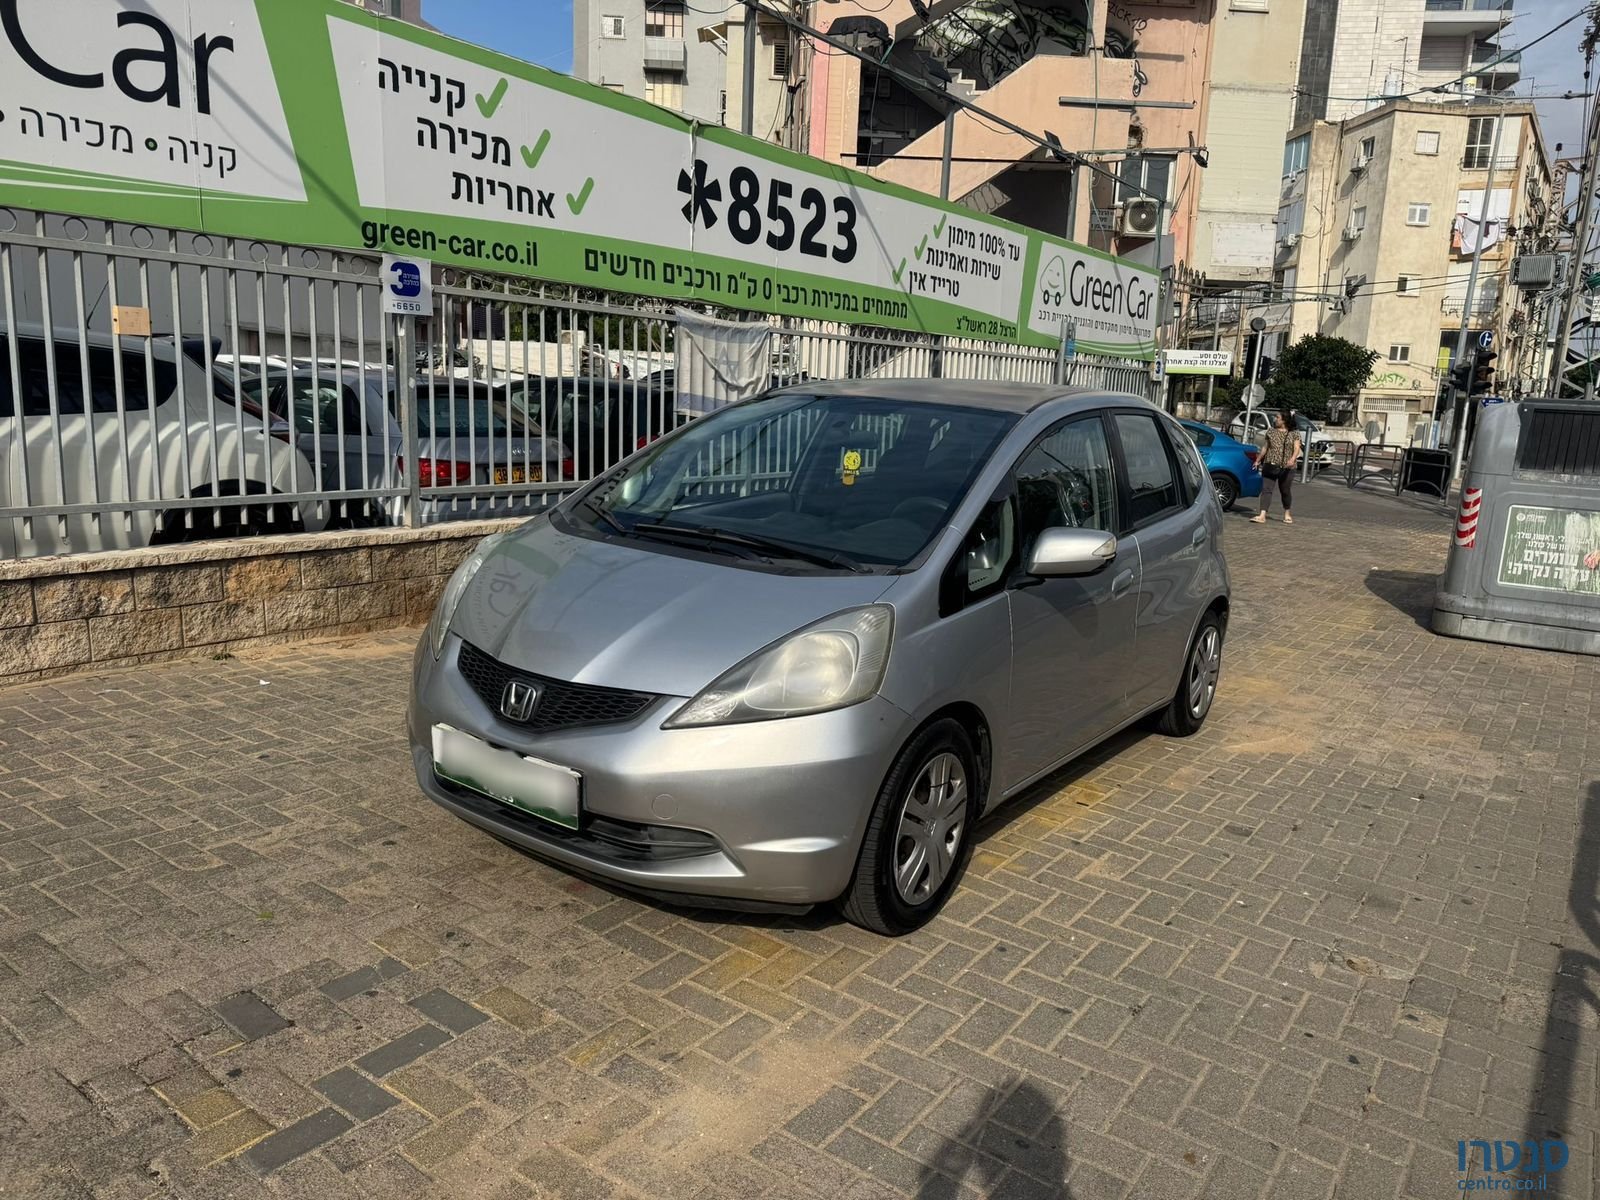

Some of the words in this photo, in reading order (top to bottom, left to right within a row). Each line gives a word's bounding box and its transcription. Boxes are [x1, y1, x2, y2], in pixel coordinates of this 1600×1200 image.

[0, 0, 234, 115] Car
[378, 58, 466, 117] קנייה
[20, 107, 133, 153] מכירה
[417, 117, 511, 167] מכירה
[168, 136, 236, 178] קניה
[451, 171, 555, 219] אחריות
[361, 220, 538, 267] green-car.co.il
[948, 225, 976, 249] מימון
[980, 232, 1005, 257] 100%
[926, 247, 969, 273] ואמינות
[1008, 243, 1020, 261] עד
[584, 248, 656, 281] חדשים
[971, 258, 1001, 280] שירות
[663, 262, 721, 292] ורכבים
[763, 278, 772, 300] 0
[909, 270, 927, 295] אין
[930, 275, 960, 297] טרייד
[776, 283, 807, 306] רכבי
[811, 288, 858, 312] במכירת
[1070, 260, 1122, 315] Green
[1127, 276, 1153, 320] Car
[862, 296, 908, 319] מתמחים
[1038, 309, 1050, 322] רכב
[988, 320, 998, 335] 28
[999, 321, 1017, 338] הרצל
[1212, 352, 1228, 360] שלם
[1523, 550, 1579, 566] שומרים
[1508, 562, 1551, 579] נקייה!
